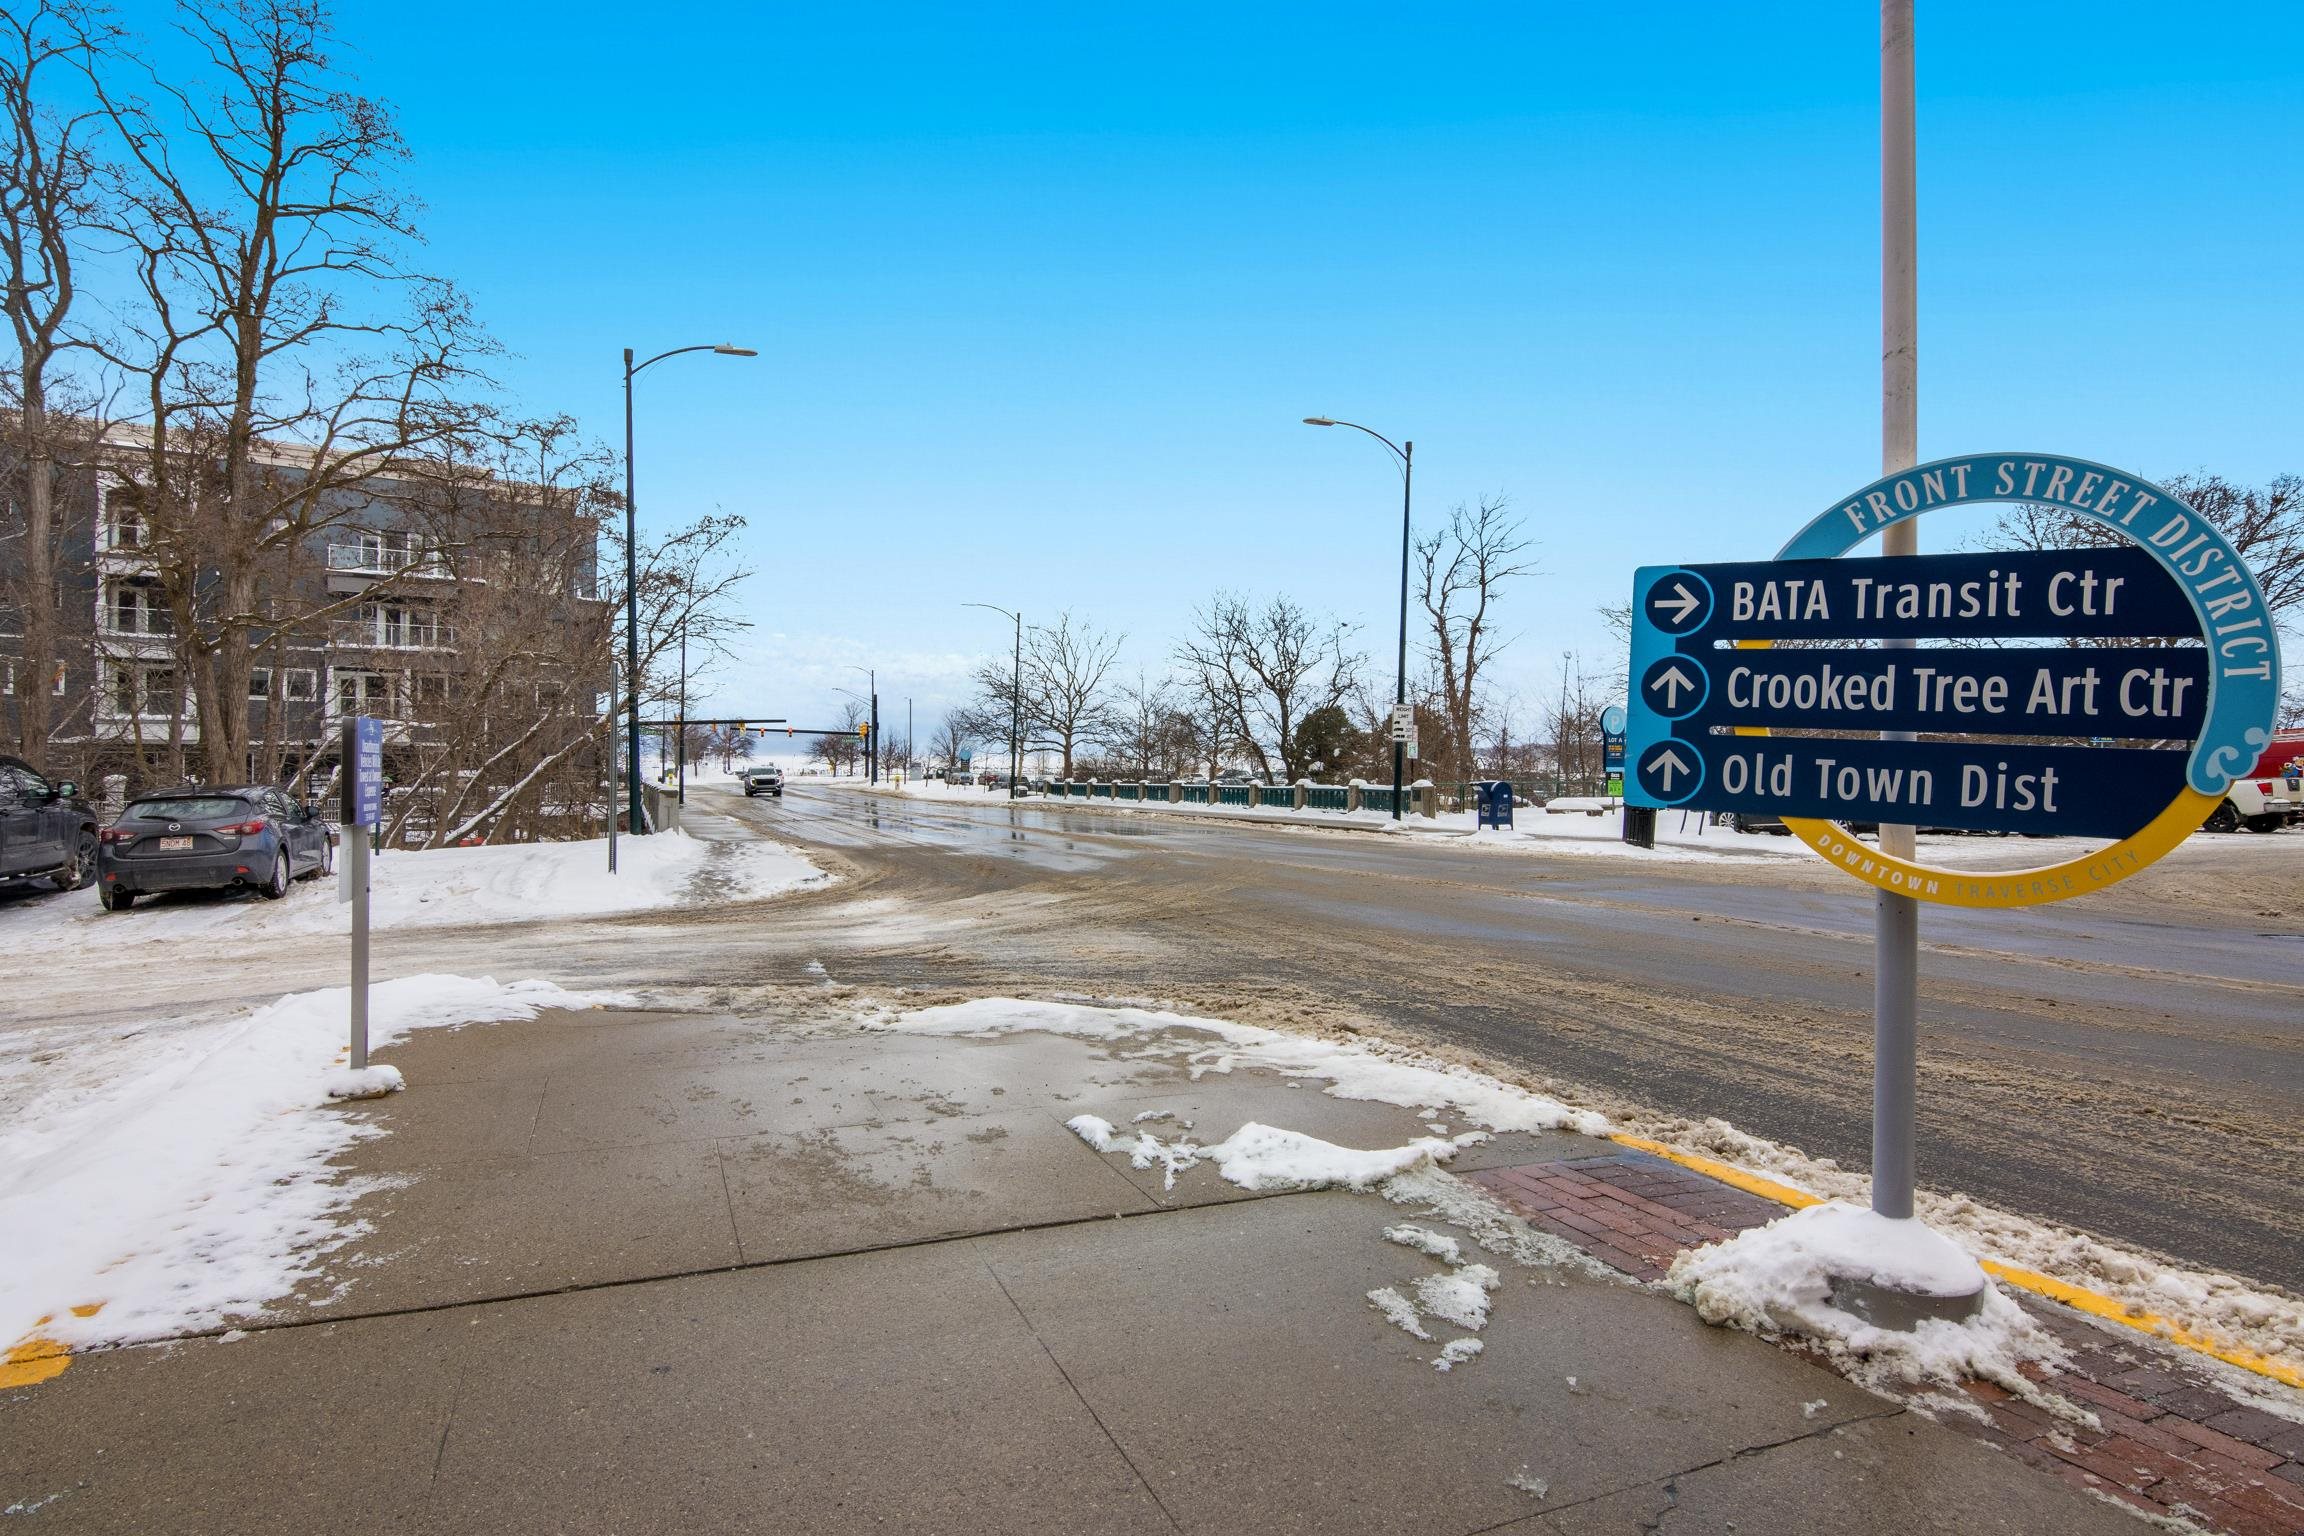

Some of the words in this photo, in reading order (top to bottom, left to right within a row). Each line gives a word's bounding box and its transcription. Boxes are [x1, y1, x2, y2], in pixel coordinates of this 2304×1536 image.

[1732, 580, 1829, 622] BATA
[1852, 569, 2023, 619] Transit
[2047, 569, 2125, 616] Ctr
[1843, 464, 1972, 534] FRONT
[1995, 461, 2159, 526] STREET
[2148, 513, 2271, 681] DISTRICT
[1727, 664, 1896, 711] Crooked
[1913, 668, 2009, 714] Tree
[2025, 667, 2101, 715] Art
[2119, 668, 2192, 718] Ctr
[1722, 753, 1793, 797] Old
[1815, 758, 1933, 805] Town
[1961, 762, 2059, 813] Dist
[1817, 834, 1939, 895] DOWNTOWN
[1954, 875, 2075, 899] TRAVERSE
[2088, 849, 2139, 882] CITY
